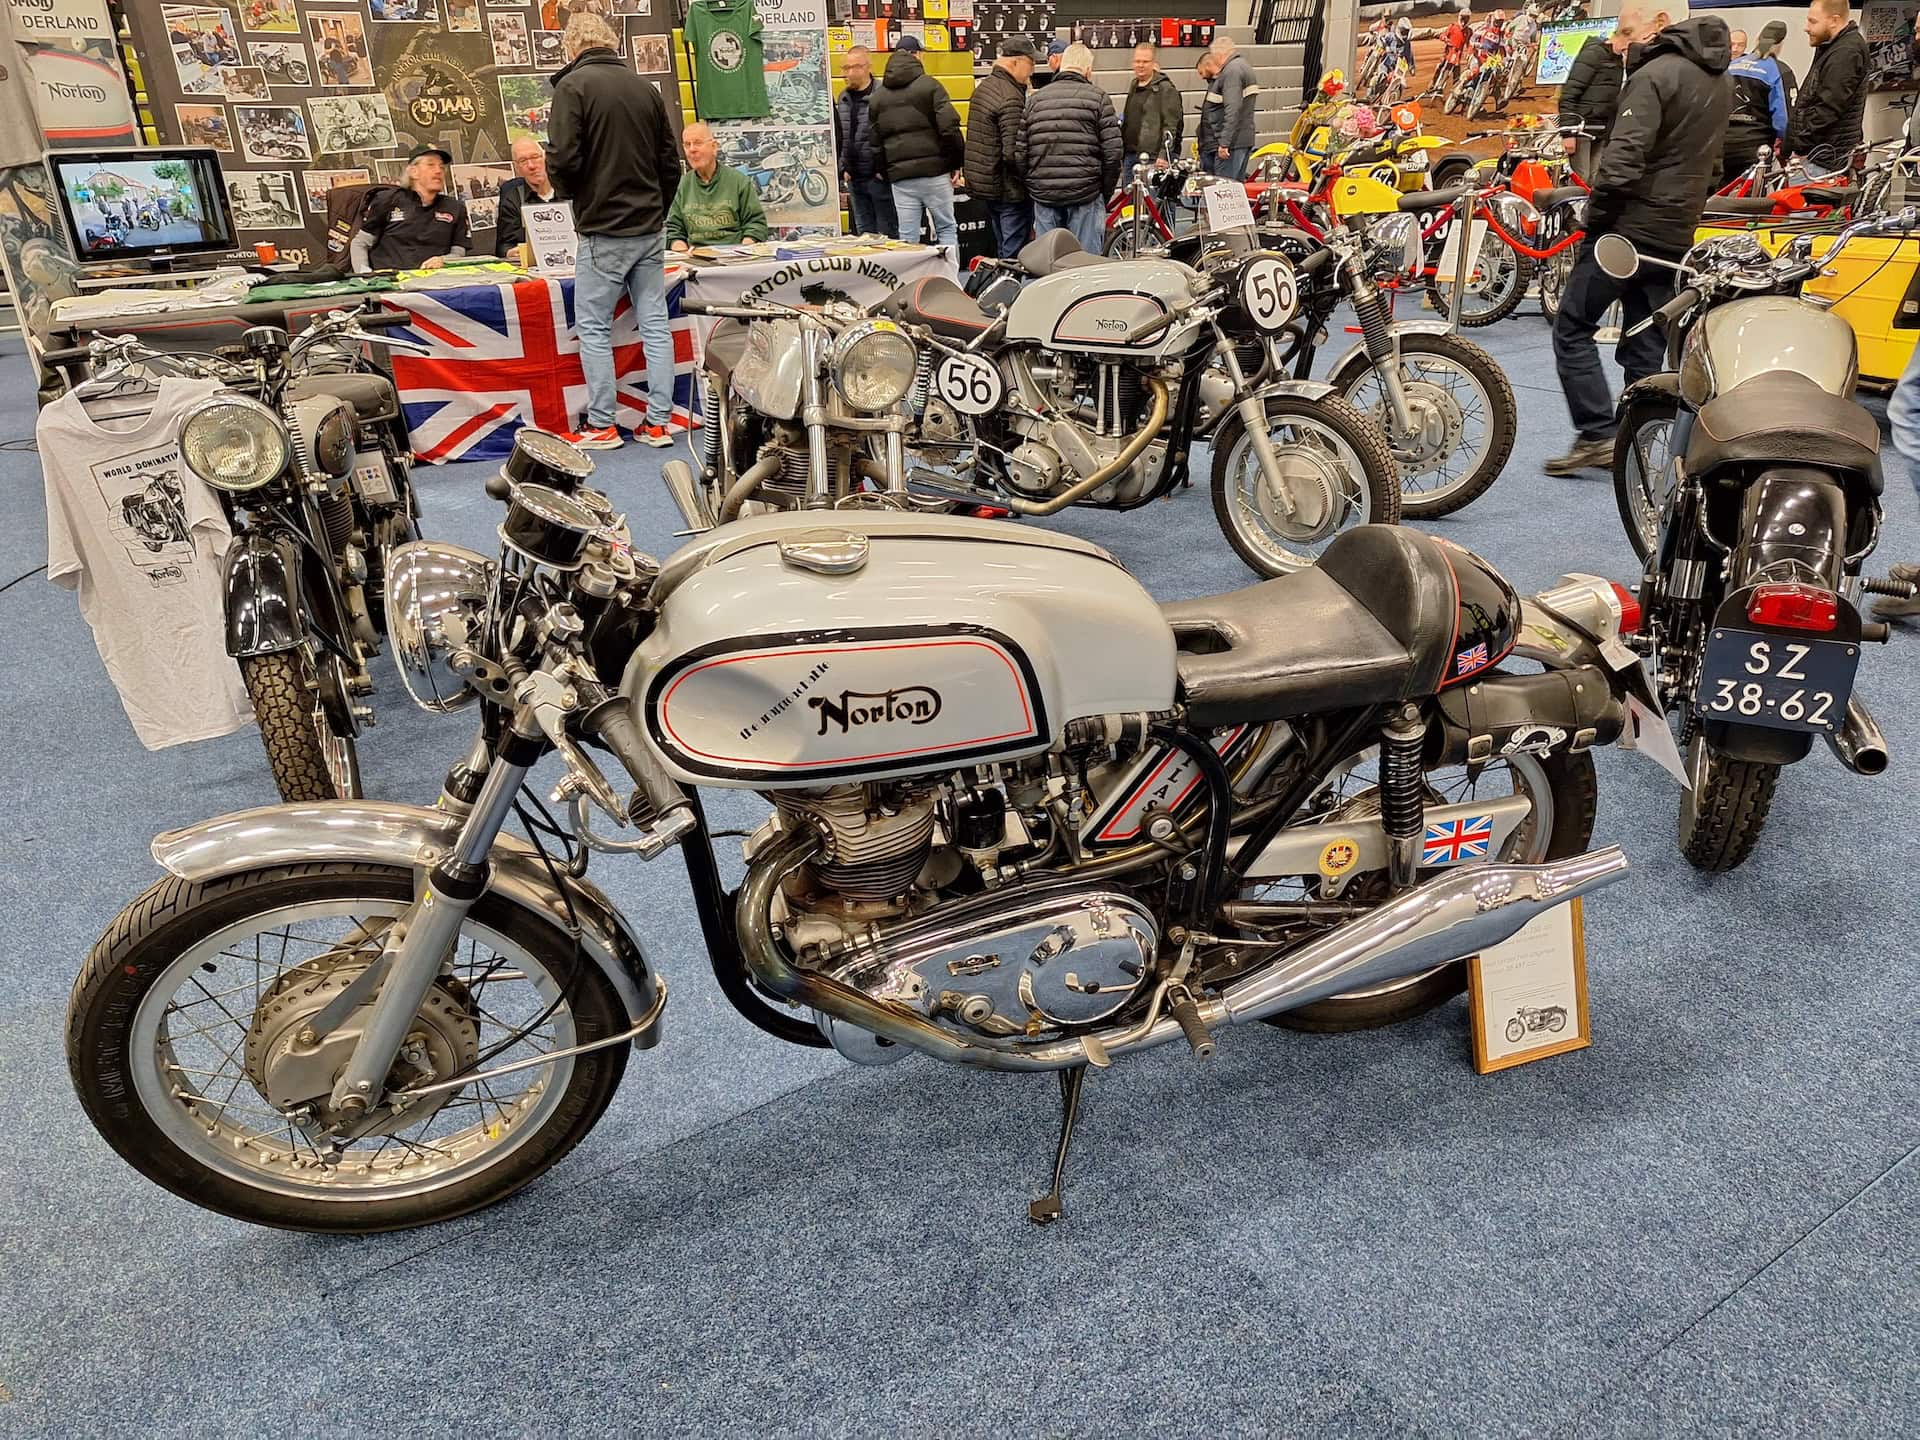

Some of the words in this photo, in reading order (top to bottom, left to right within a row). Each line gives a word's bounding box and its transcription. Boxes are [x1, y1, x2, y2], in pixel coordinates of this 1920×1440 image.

[41, 81, 106, 103] Norton
[420, 98, 438, 113] 50
[438, 96, 474, 115] JAAR
[808, 257, 852, 273] CLUB
[1252, 267, 1292, 318] 56
[1096, 318, 1128, 332] Norton
[947, 363, 992, 405] 56
[103, 465, 132, 478] WORLD
[149, 567, 182, 581] Norton
[808, 685, 942, 735] Norton
[1710, 679, 1834, 725] 38-62
